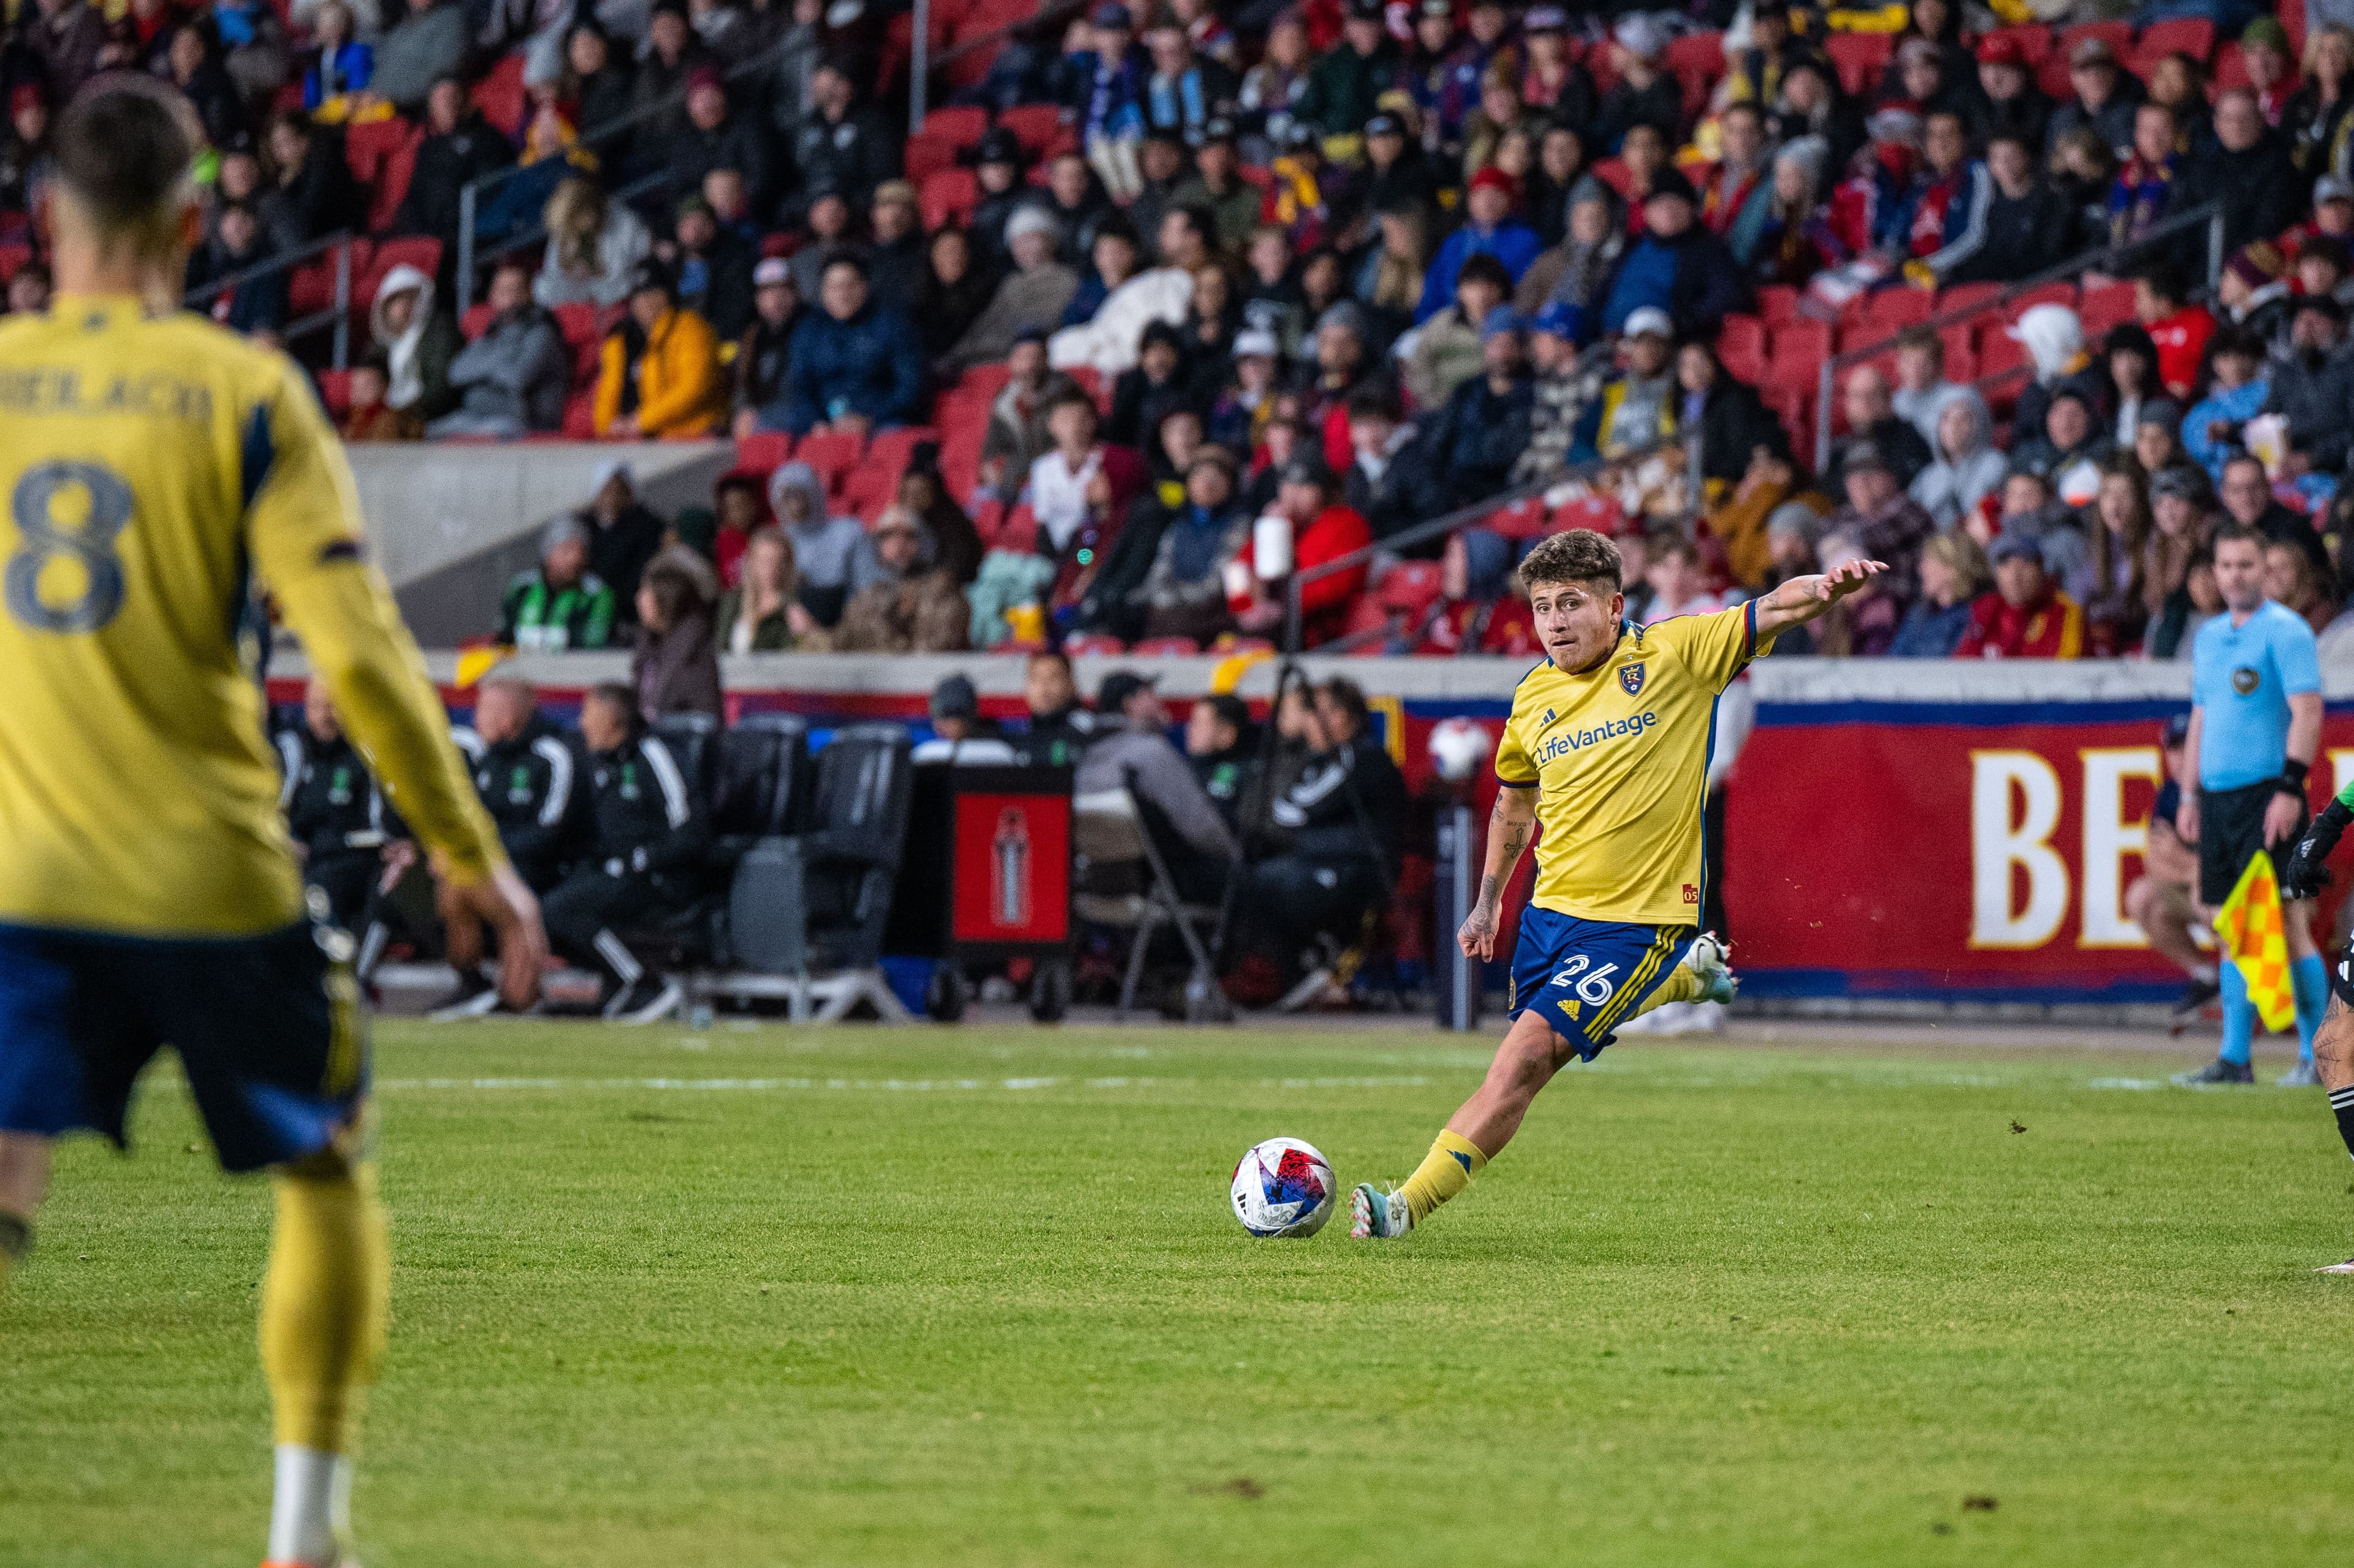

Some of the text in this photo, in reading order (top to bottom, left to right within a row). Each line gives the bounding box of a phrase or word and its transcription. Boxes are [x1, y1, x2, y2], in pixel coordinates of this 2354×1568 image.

[3, 455, 133, 636] 8
[1536, 711, 1657, 764] LifeVantage
[1684, 891, 1698, 901] 05
[1550, 954, 1619, 1007] 26
